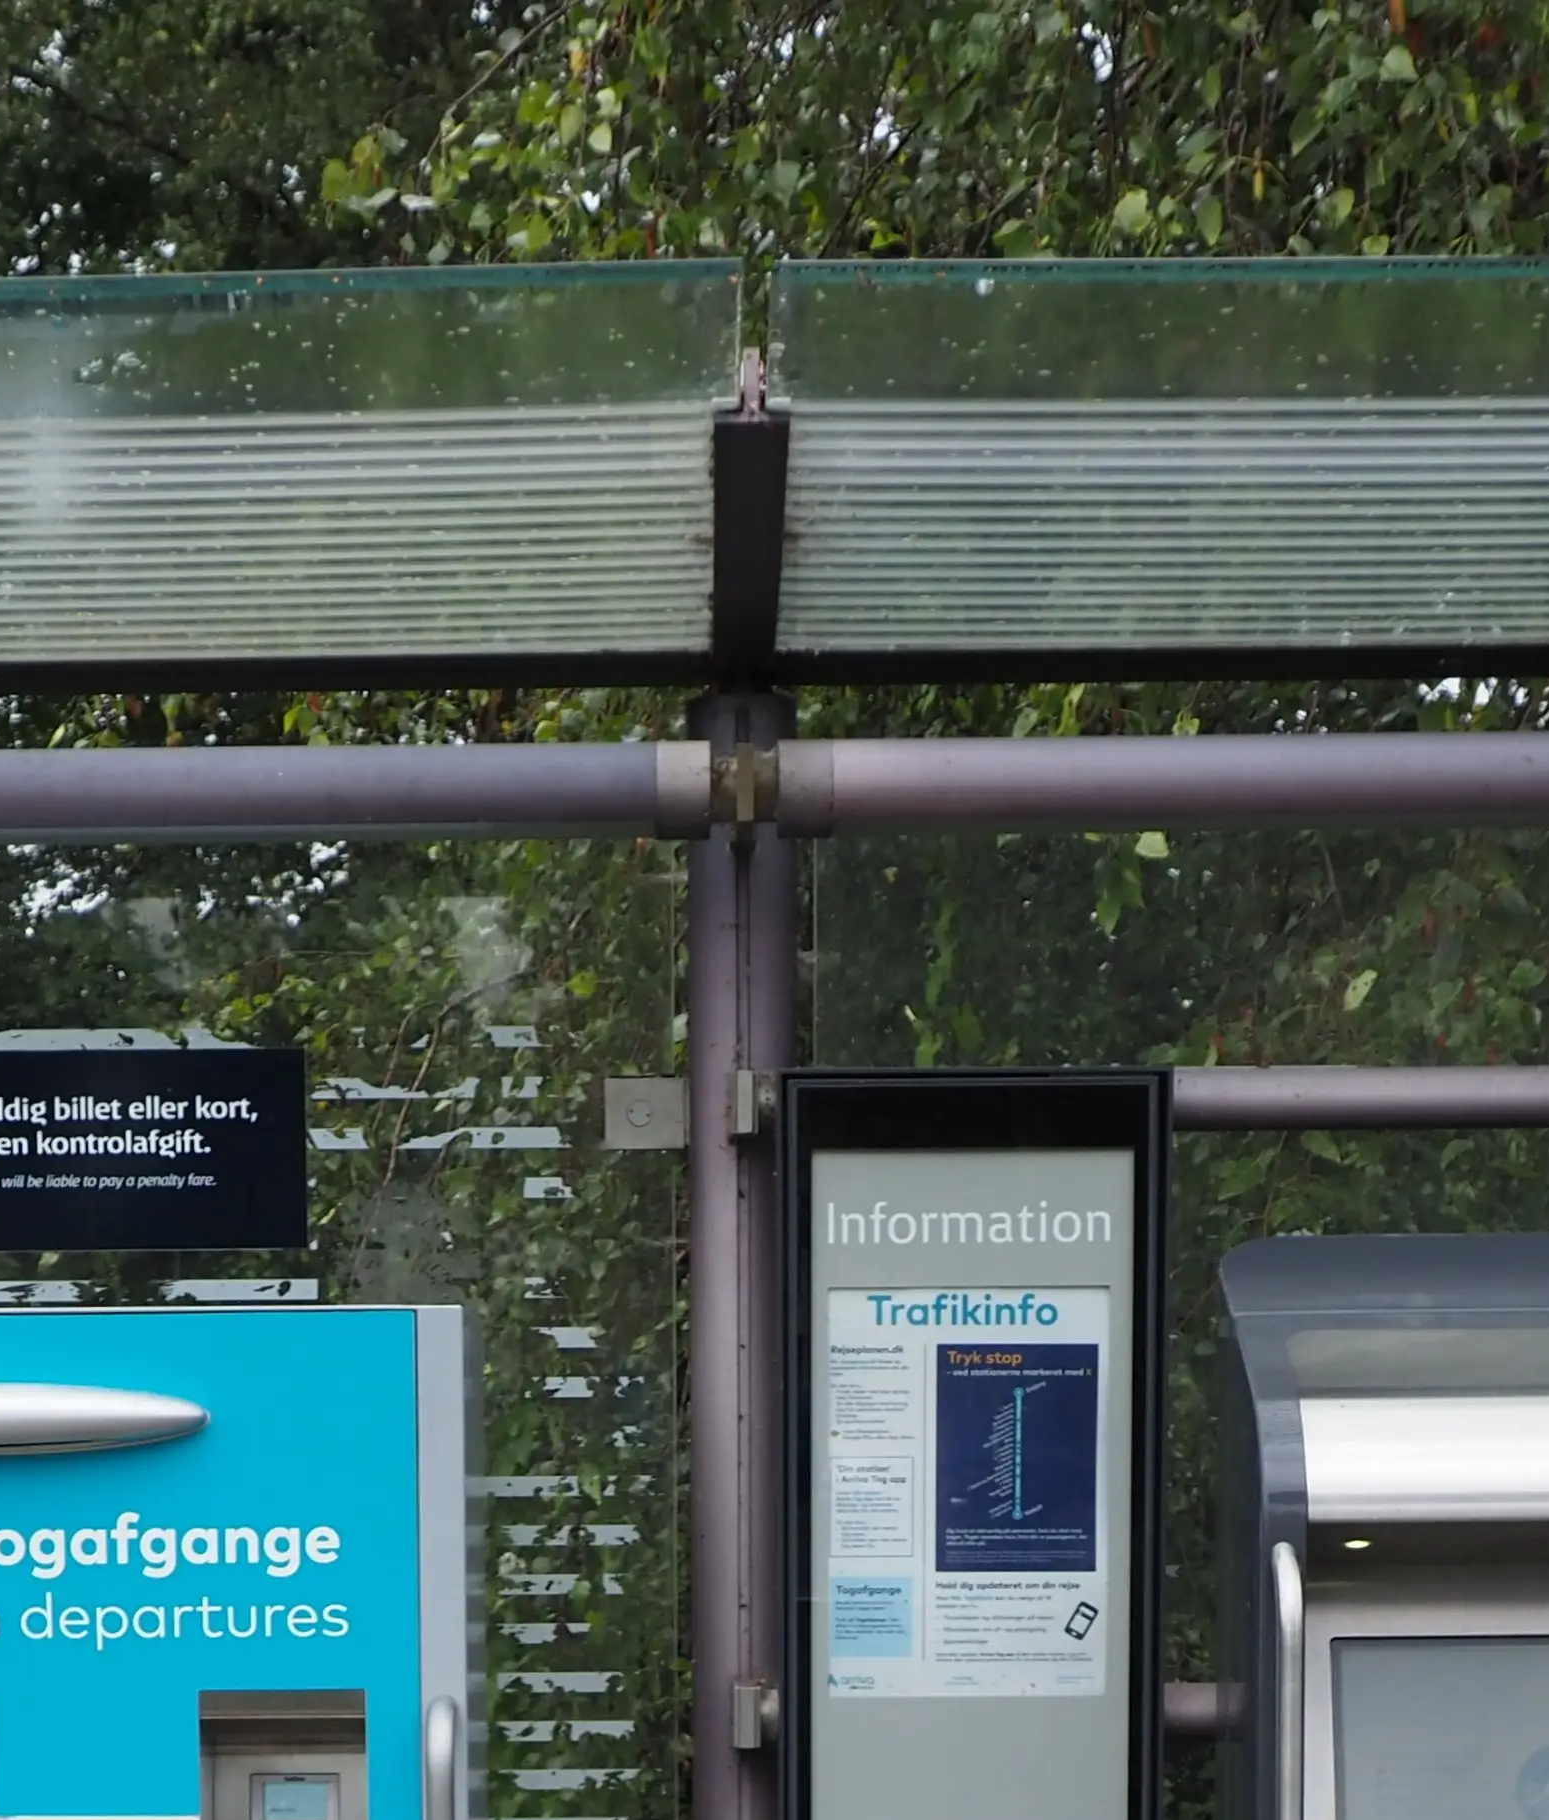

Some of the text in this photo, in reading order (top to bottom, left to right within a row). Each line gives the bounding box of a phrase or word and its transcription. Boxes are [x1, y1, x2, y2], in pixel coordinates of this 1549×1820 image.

[53, 1095, 122, 1121] billet
[127, 1094, 189, 1120] eller
[194, 1094, 258, 1123] kort,
[36, 1128, 212, 1159] kontrolafgift.
[0, 1174, 25, 1189] will
[26, 1173, 44, 1188] be
[44, 1173, 82, 1188] liable
[82, 1175, 98, 1188] to
[97, 1175, 125, 1190] pay
[124, 1175, 136, 1187] a
[136, 1172, 186, 1190] penalty
[186, 1171, 217, 1186] fare.
[826, 1199, 1111, 1245] Information
[867, 1293, 1058, 1327] Trafikinfo
[946, 1349, 1022, 1367] Tryk stop
[20, 1589, 349, 1651] departures
